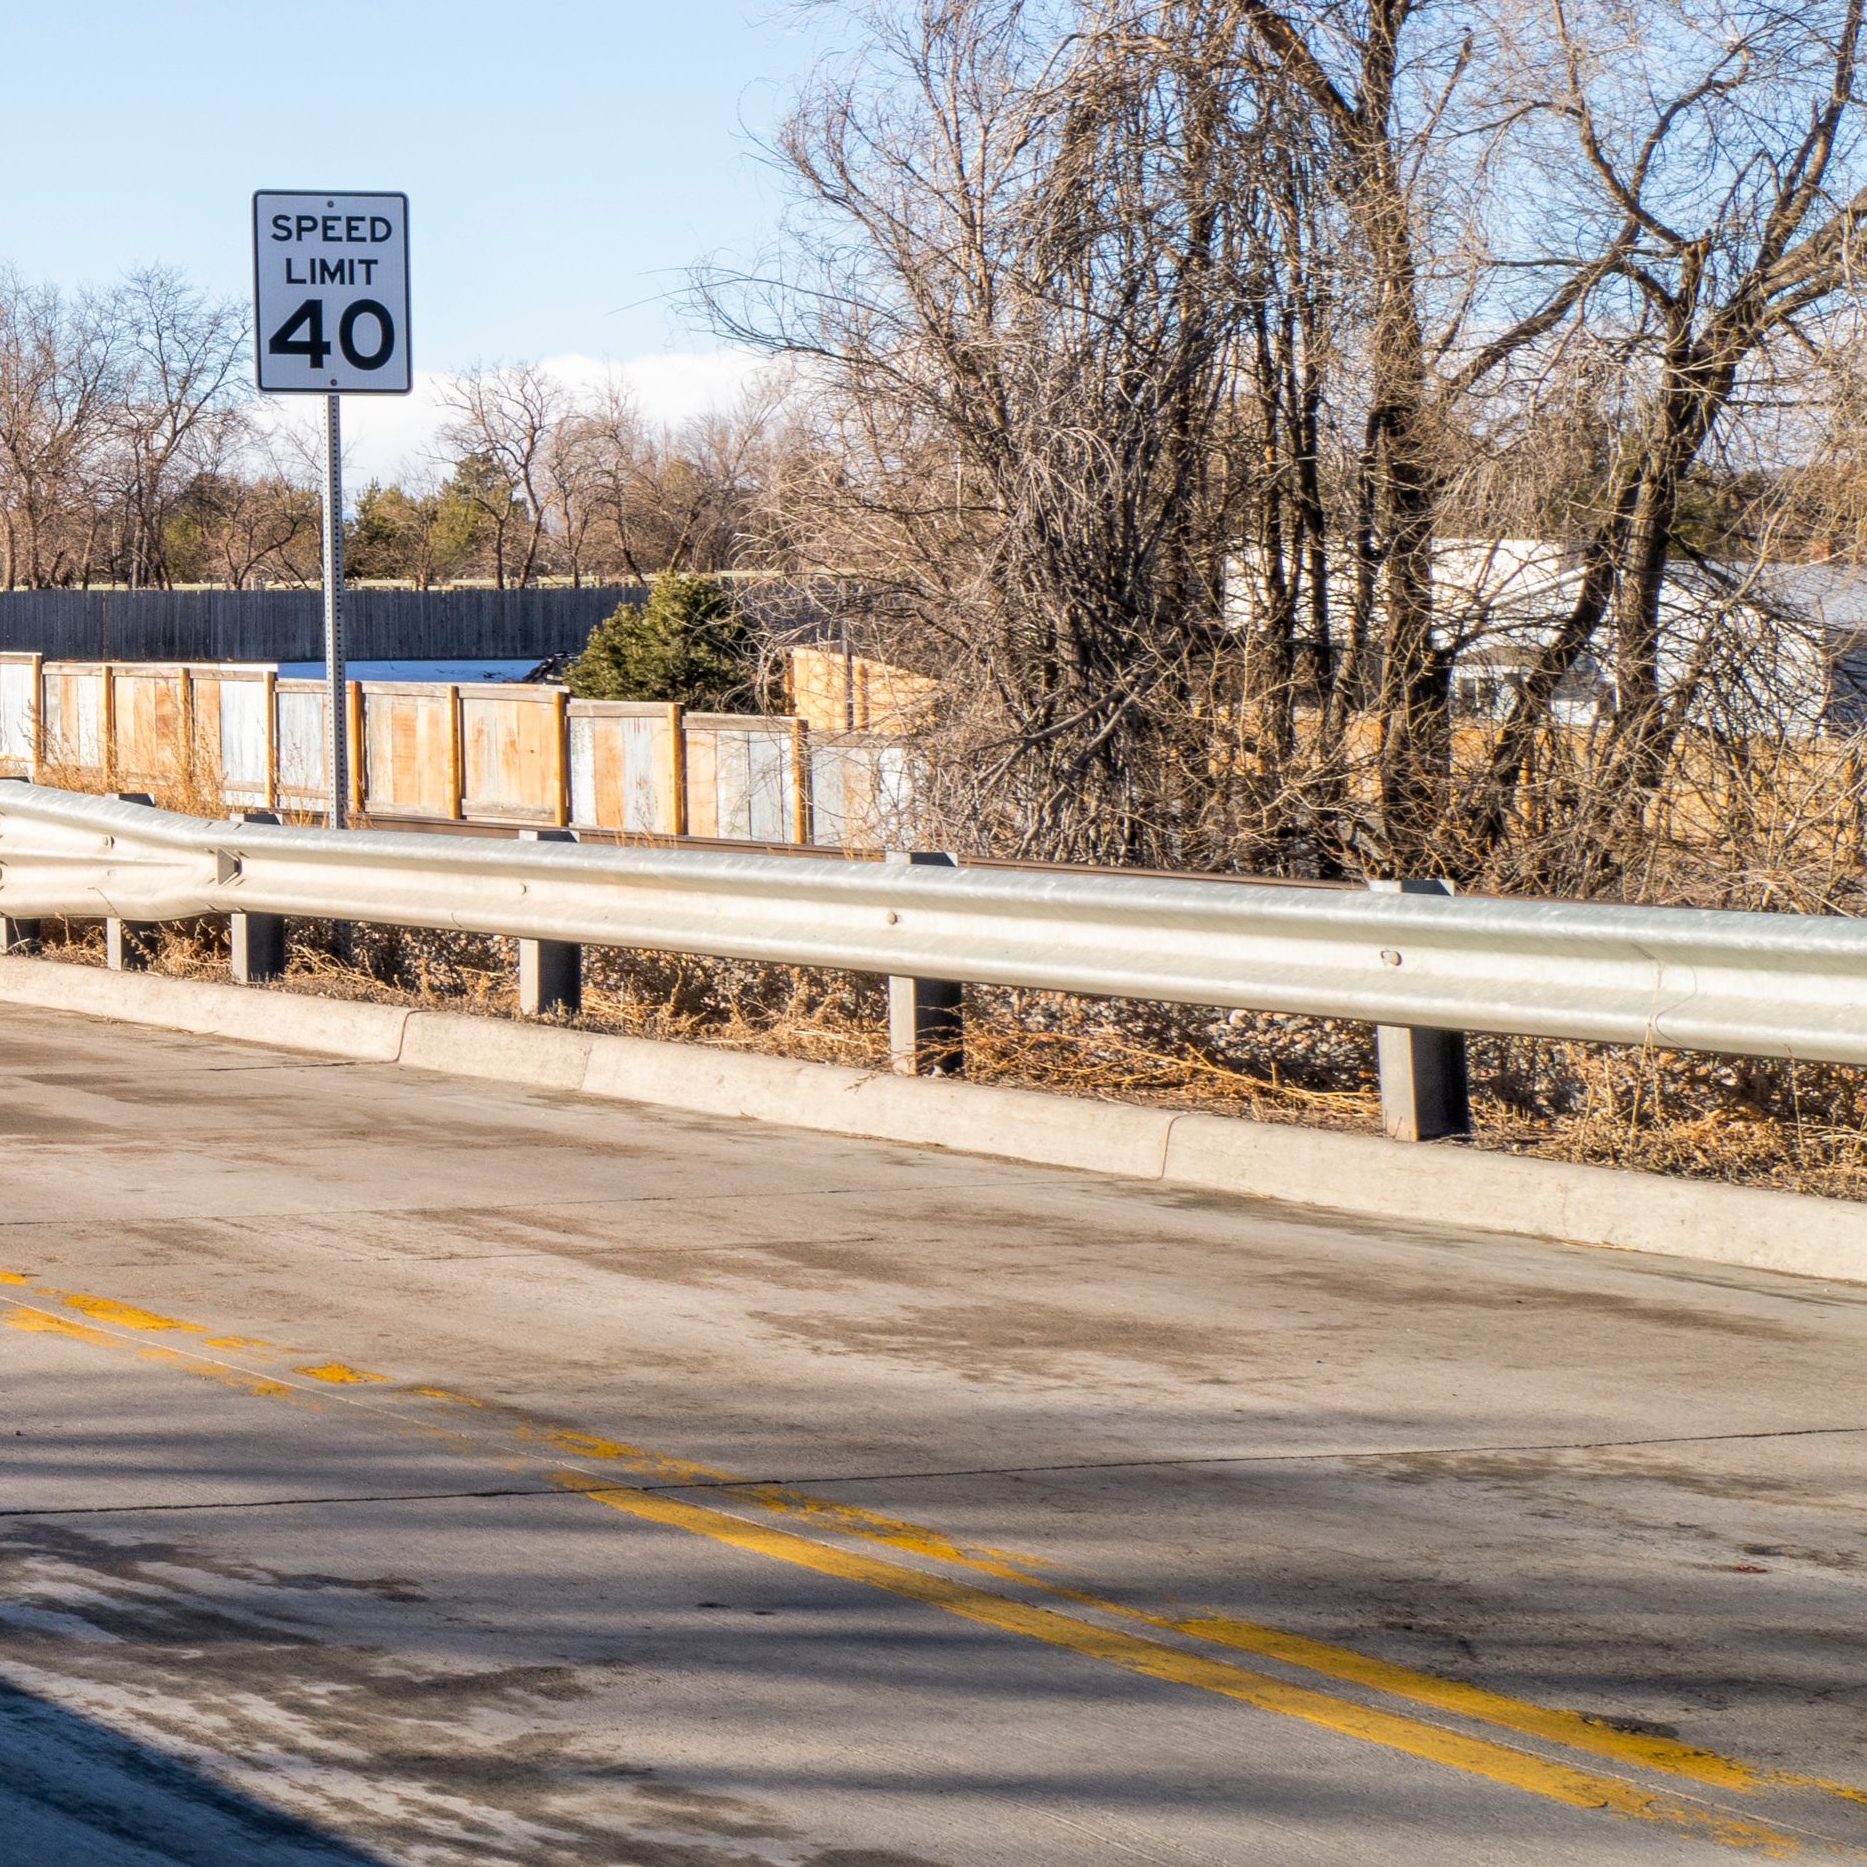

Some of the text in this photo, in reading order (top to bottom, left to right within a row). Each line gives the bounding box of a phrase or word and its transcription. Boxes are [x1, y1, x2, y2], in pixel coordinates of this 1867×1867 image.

[271, 214, 393, 243] SPEED
[285, 257, 379, 286] LIMIT
[268, 298, 395, 371] 40
